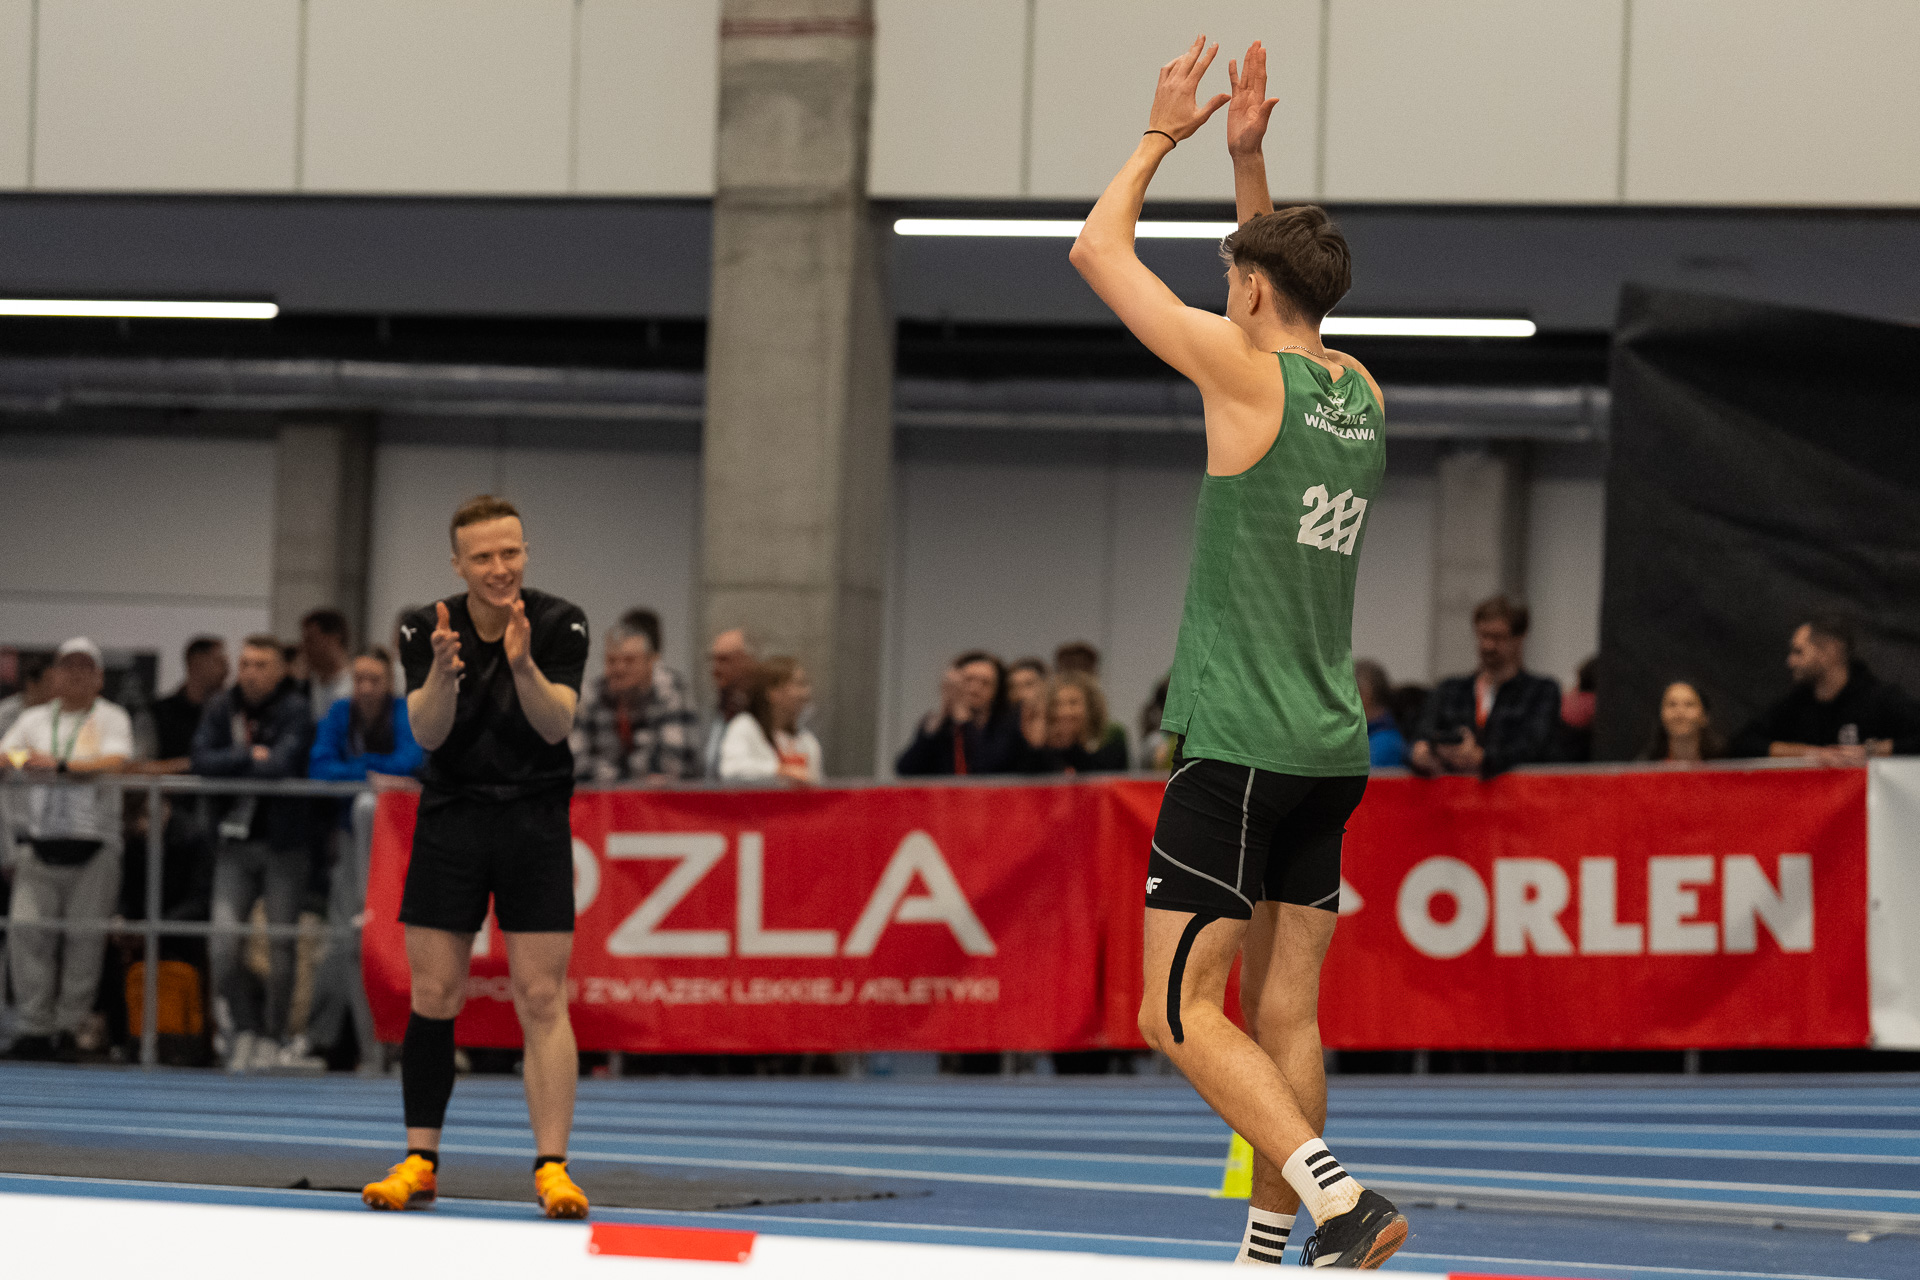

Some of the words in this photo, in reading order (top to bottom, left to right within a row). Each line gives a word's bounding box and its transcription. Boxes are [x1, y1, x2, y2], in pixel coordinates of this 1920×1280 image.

[1304, 412, 1375, 441] WARSZAWA
[1316, 402, 1342, 422] AZS
[1397, 853, 1815, 960] ORLEN
